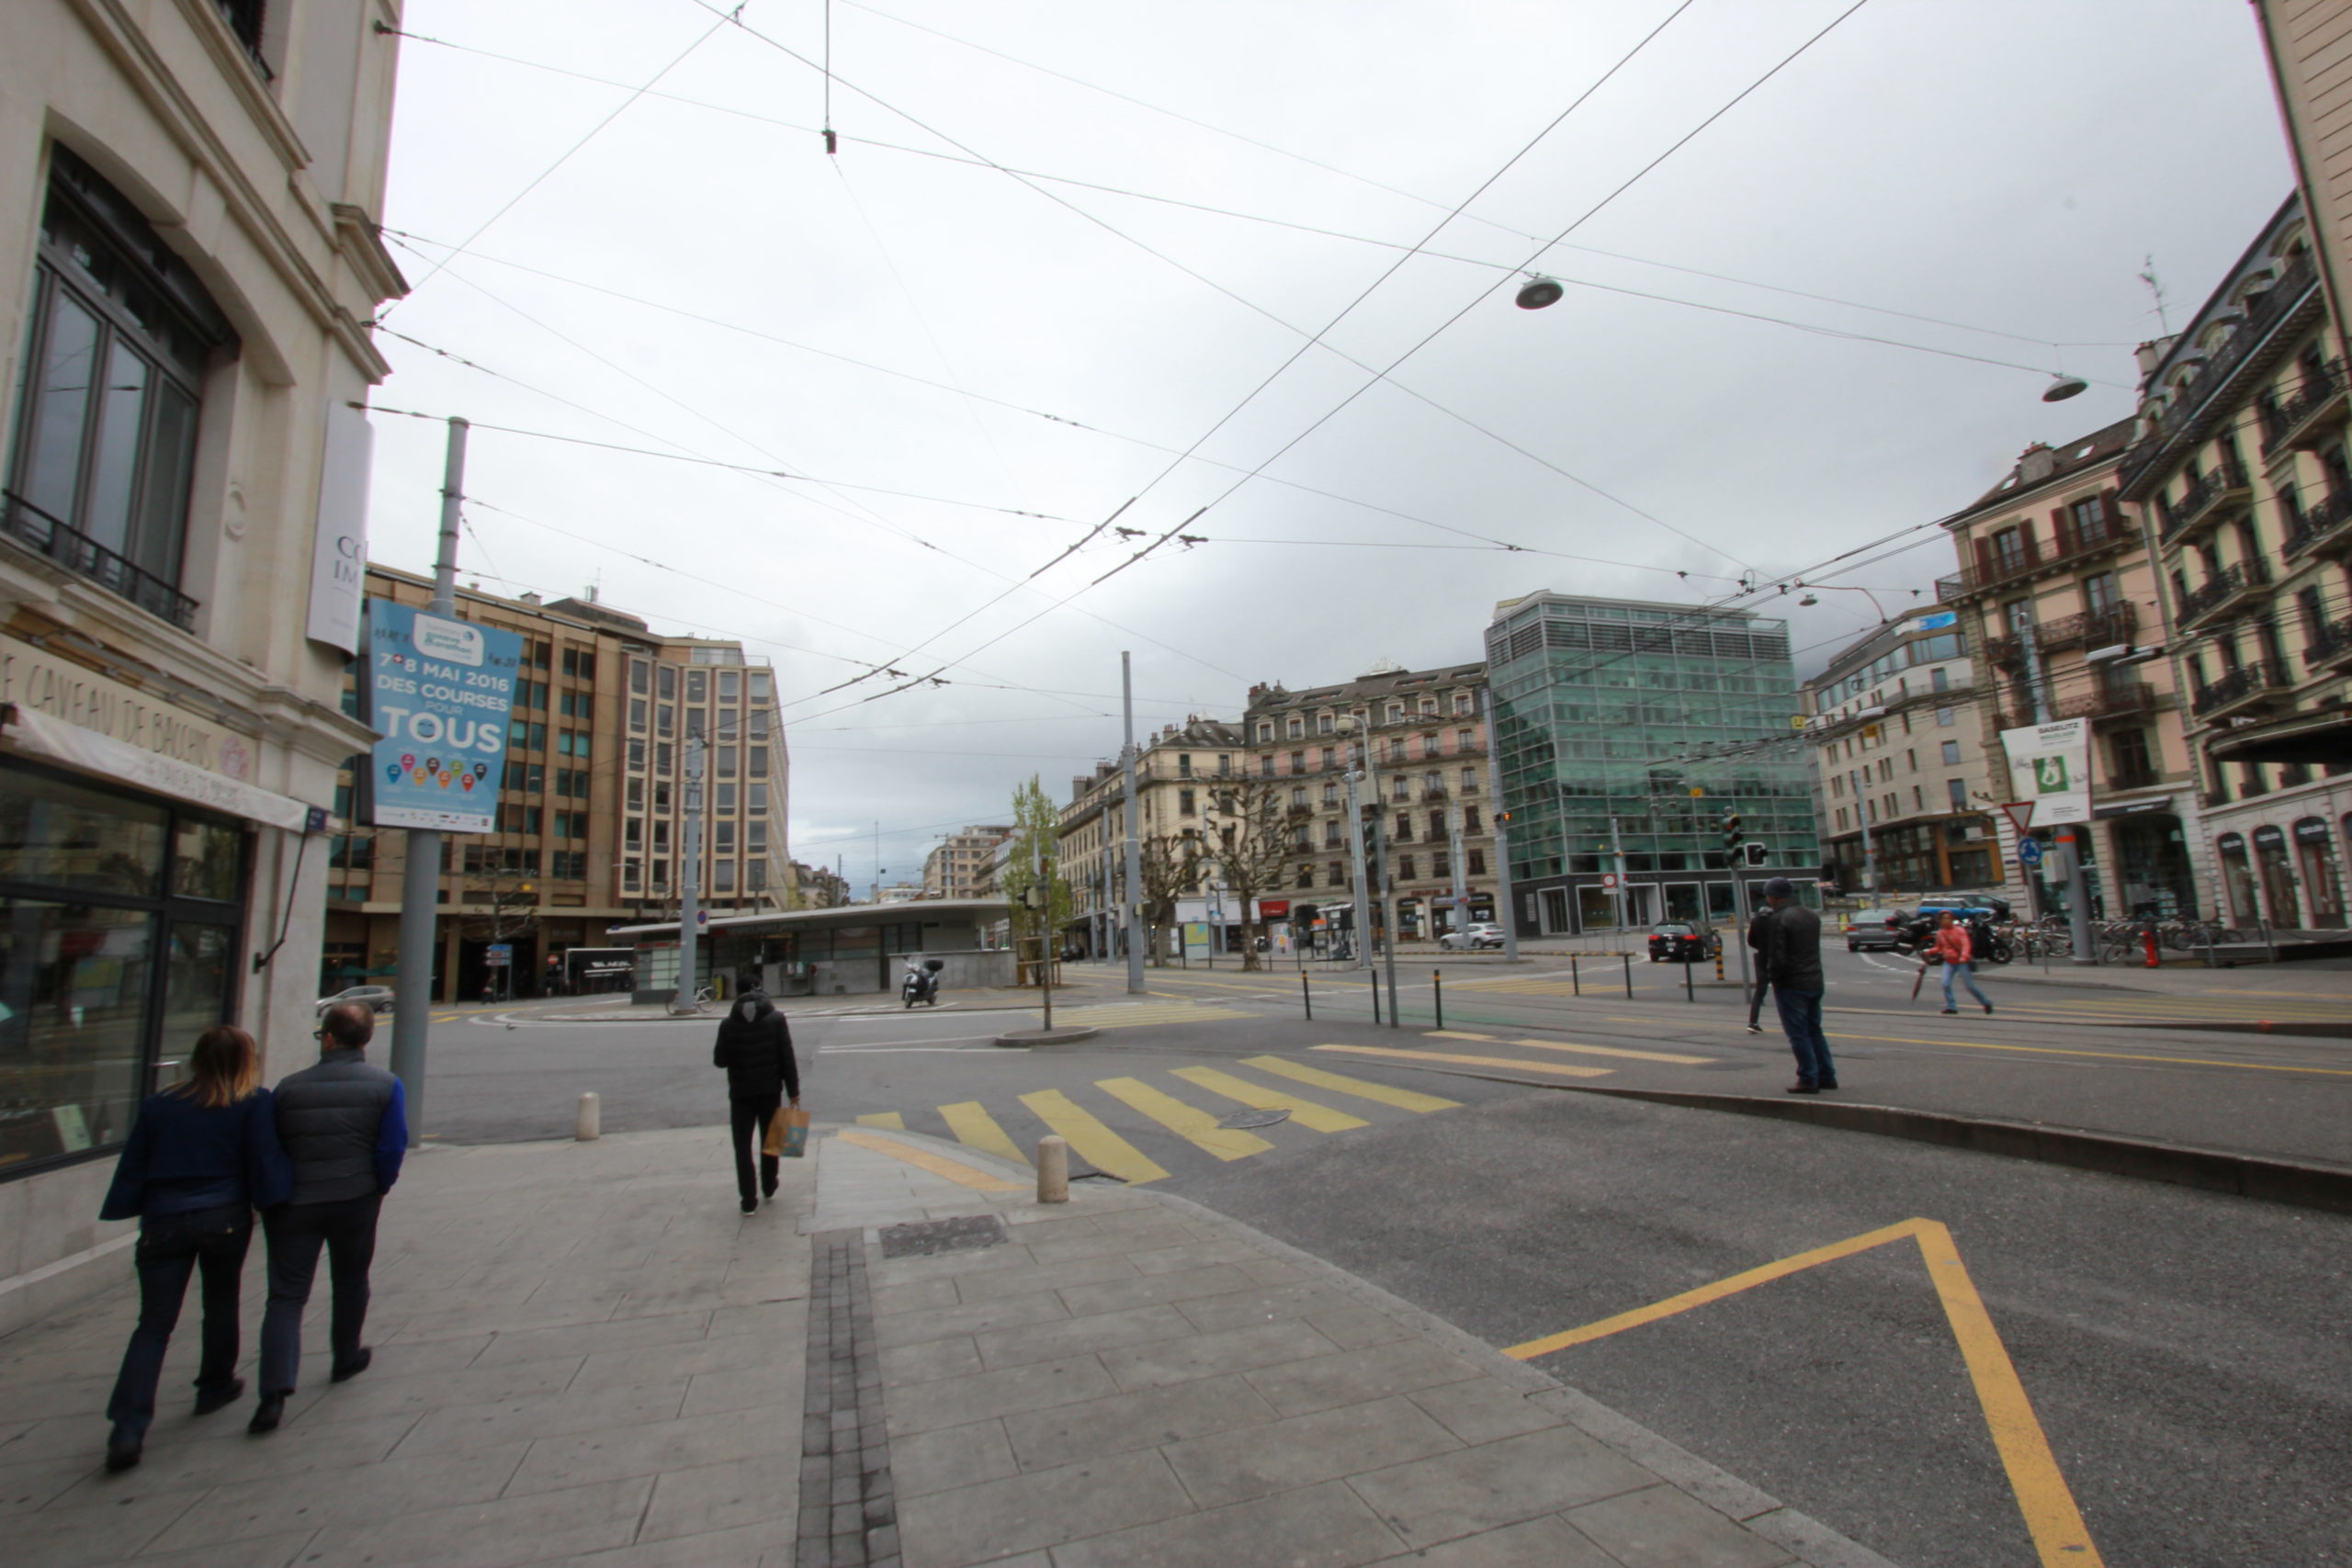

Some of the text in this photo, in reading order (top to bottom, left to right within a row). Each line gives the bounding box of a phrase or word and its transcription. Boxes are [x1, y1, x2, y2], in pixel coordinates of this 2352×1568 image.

[377, 674, 508, 712] DES COURSES
[423, 662, 459, 682] MAI
[466, 671, 510, 692] 2016
[425, 700, 463, 716] POUR
[379, 705, 502, 753] TOUS
